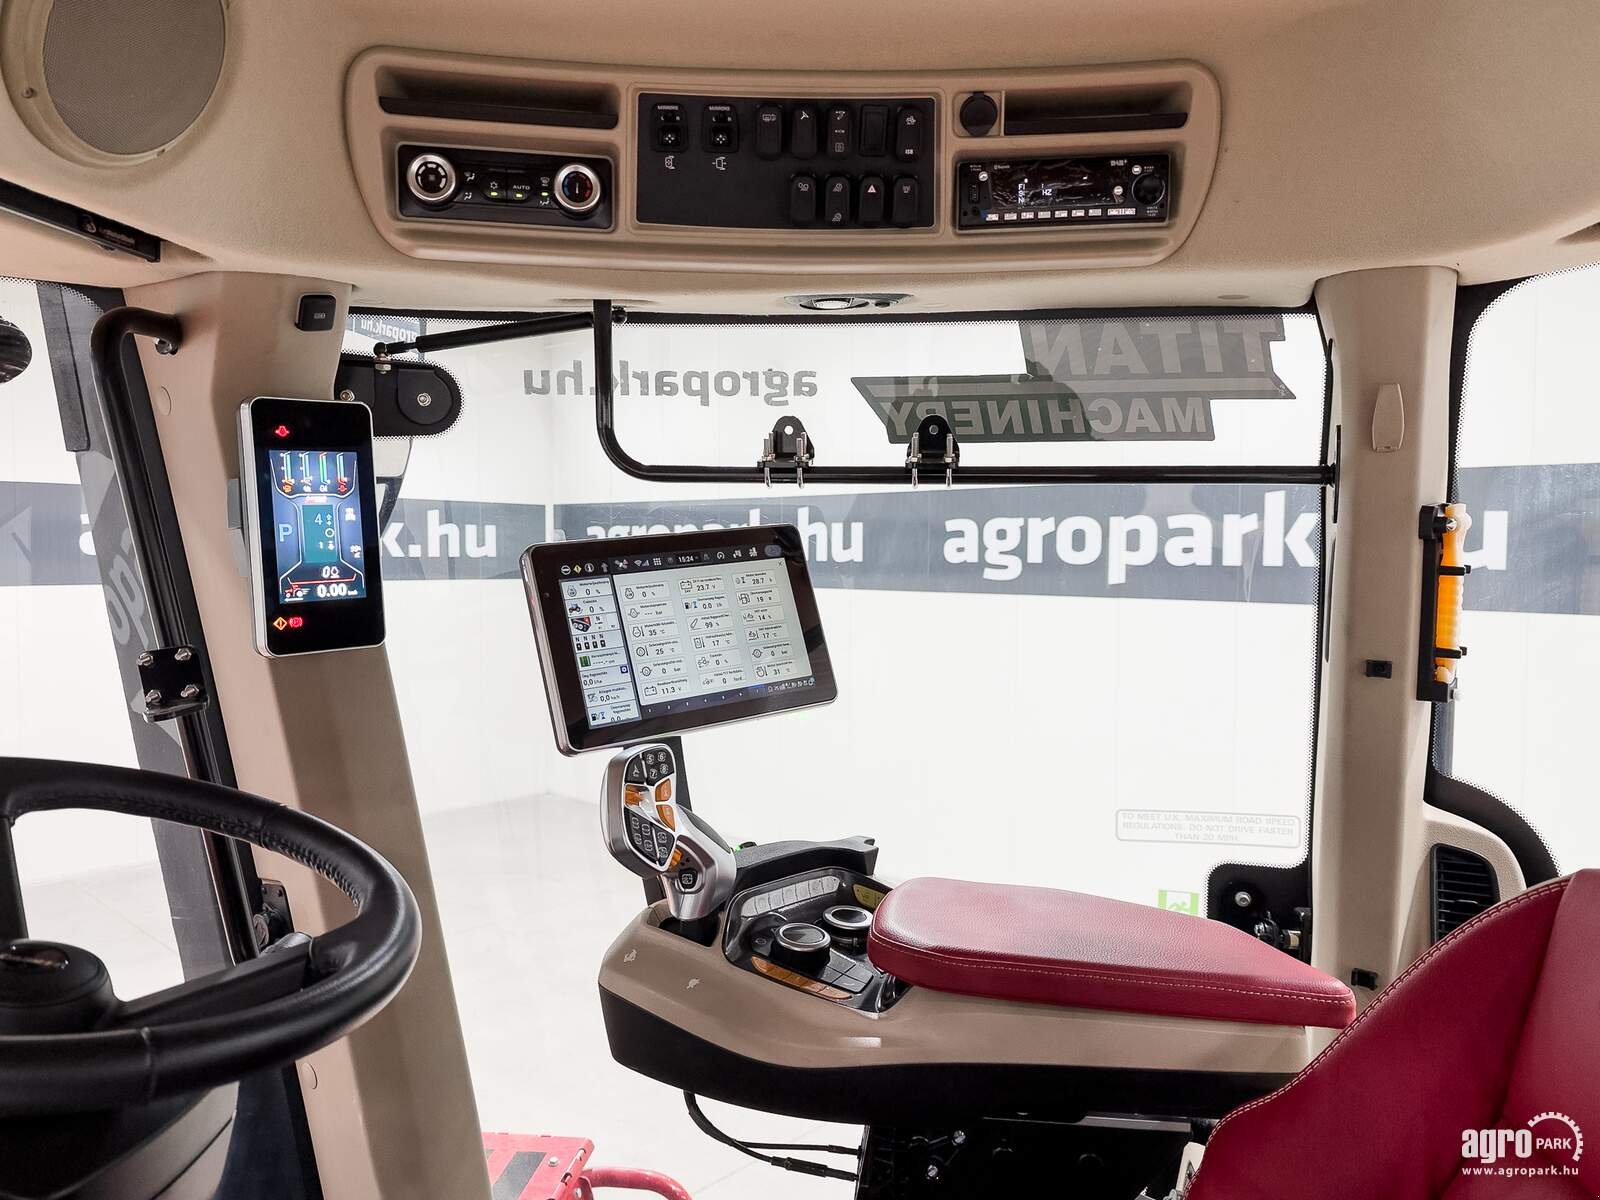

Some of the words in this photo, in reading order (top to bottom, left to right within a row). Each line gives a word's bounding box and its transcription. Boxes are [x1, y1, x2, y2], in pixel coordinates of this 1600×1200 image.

[278, 524, 294, 542] P
[696, 583, 710, 592] 23.7
[752, 578, 765, 586] 28.7
[316, 583, 347, 598] 0.00
